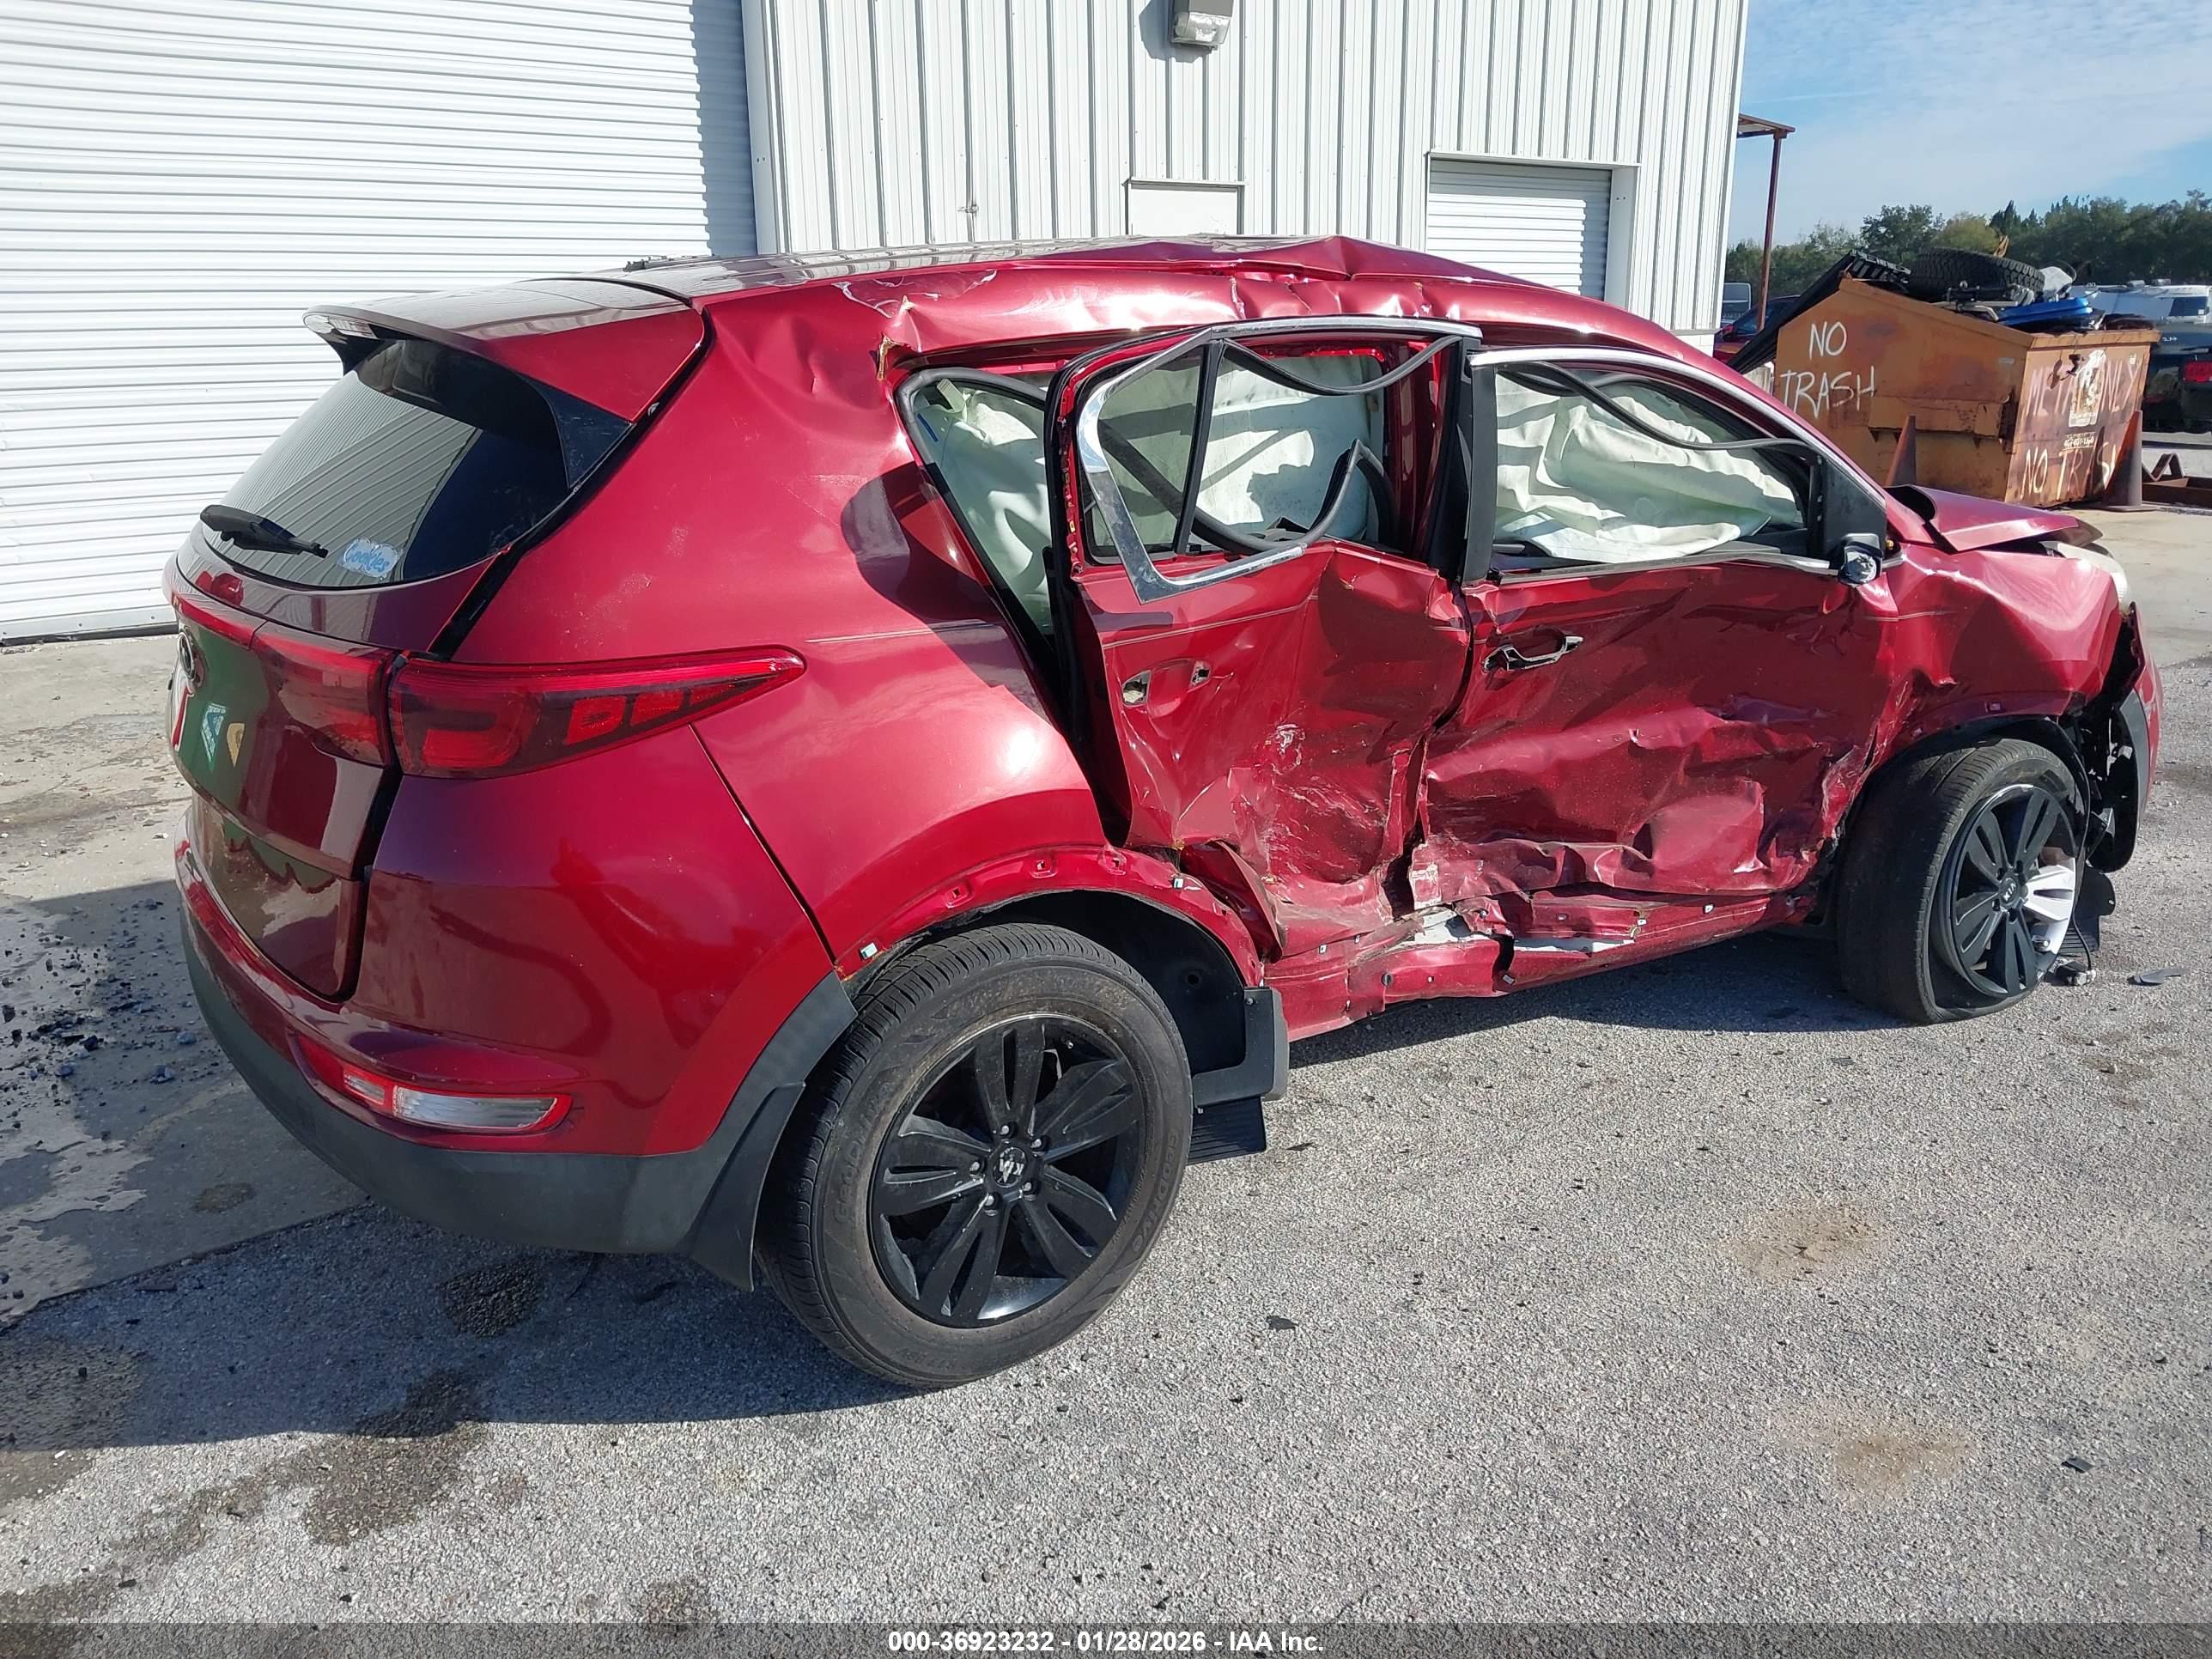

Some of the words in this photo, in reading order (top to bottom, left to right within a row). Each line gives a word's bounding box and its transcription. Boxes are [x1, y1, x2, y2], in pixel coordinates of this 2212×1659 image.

[1808, 320, 1847, 361] NO
[1780, 365, 1875, 419] TRASH
[2020, 446, 2048, 500] NO
[2002, 883, 2016, 902] KIA
